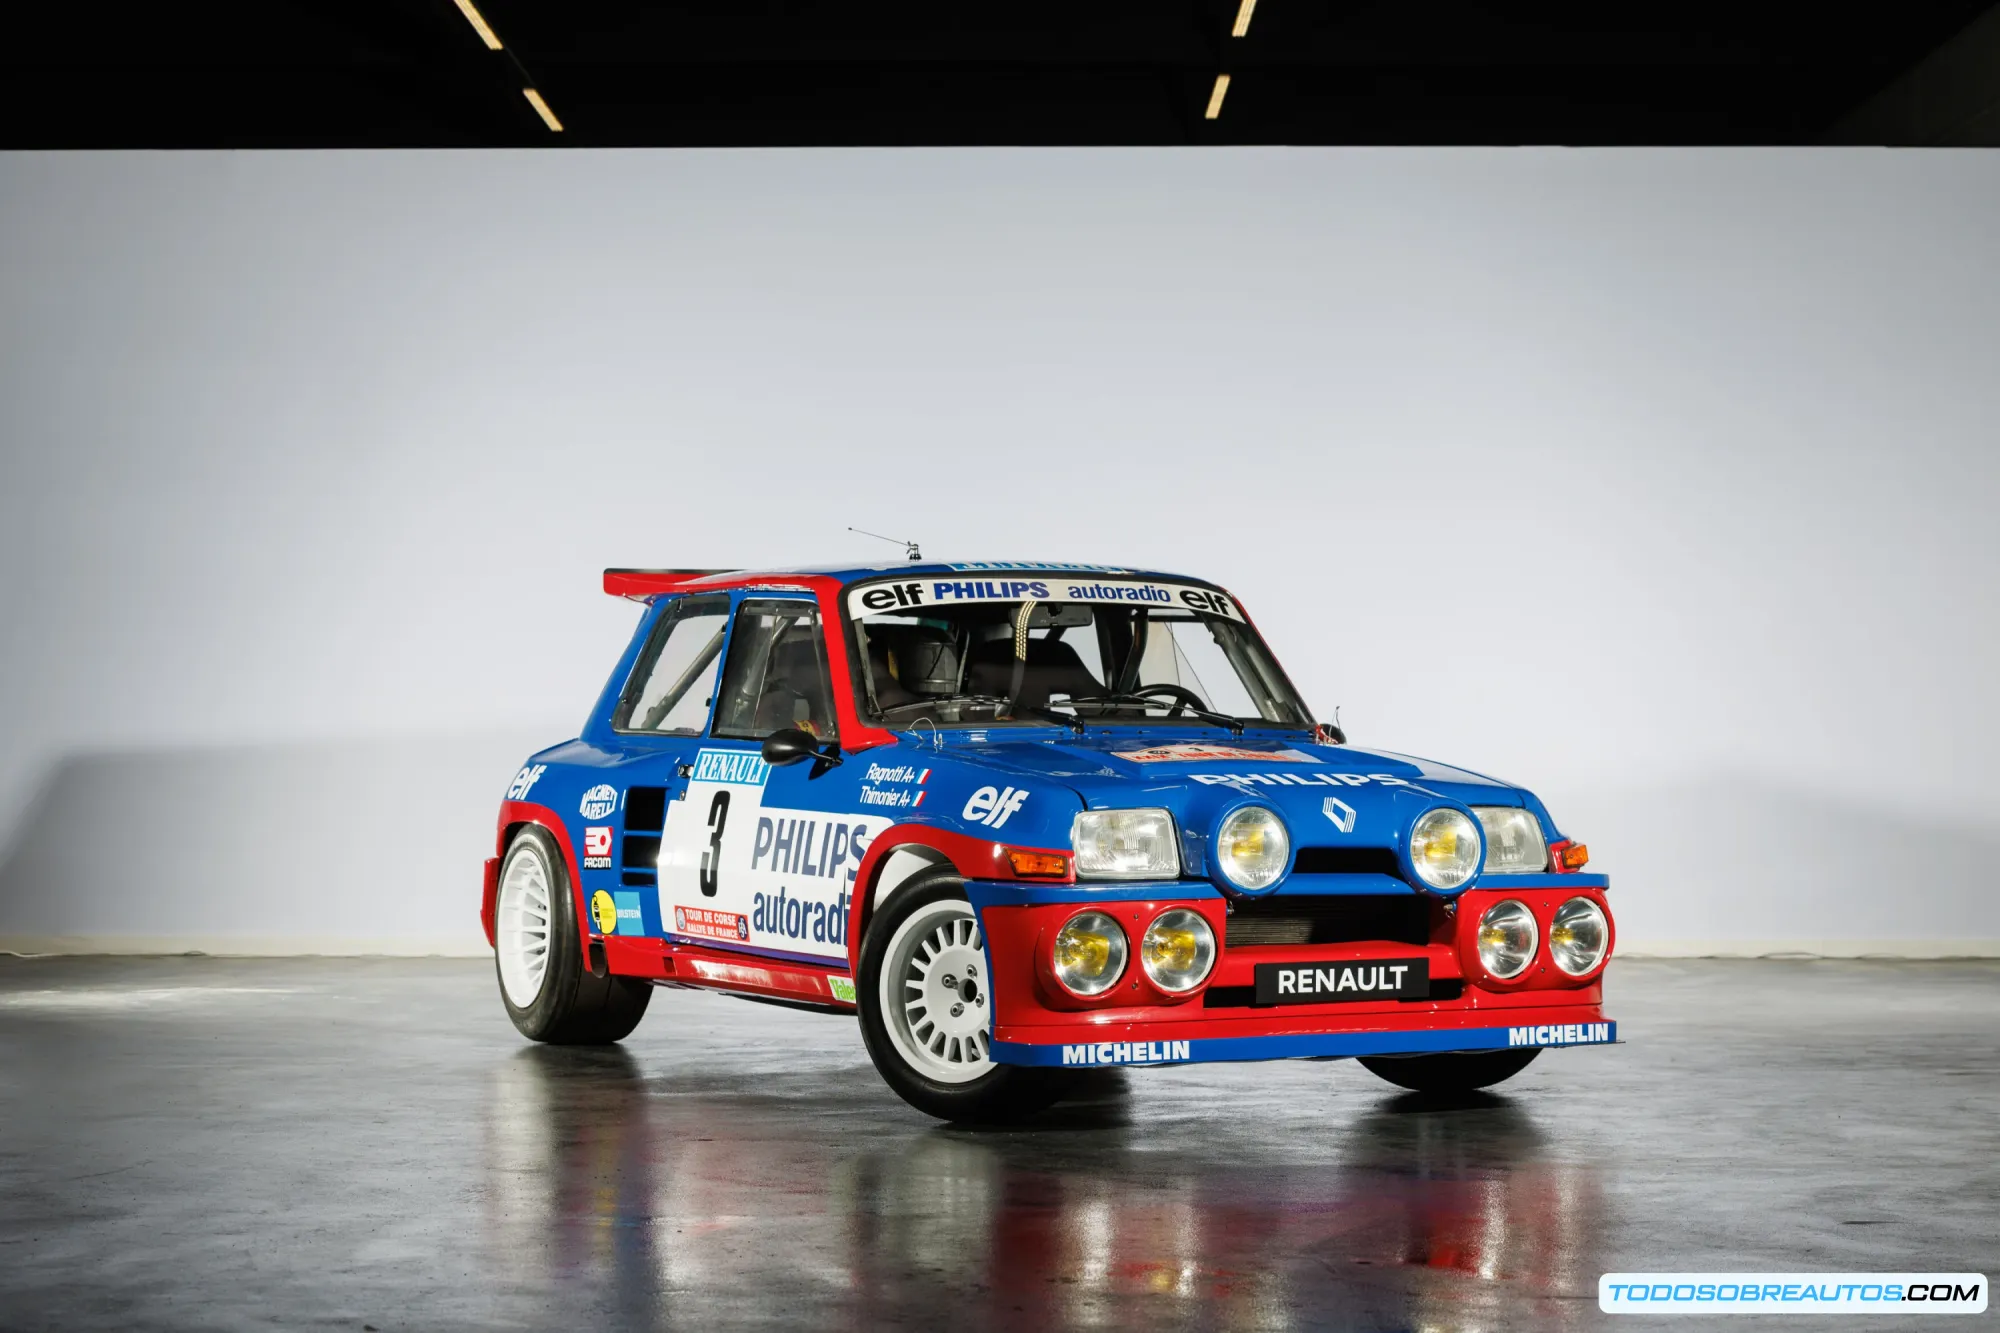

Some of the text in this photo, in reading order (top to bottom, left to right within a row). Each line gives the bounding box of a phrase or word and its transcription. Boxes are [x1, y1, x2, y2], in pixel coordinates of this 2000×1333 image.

[862, 581, 1230, 616] elf PHILIPS autoradio elf
[694, 753, 768, 784] RENAULT
[865, 762, 907, 785] Ragnotti
[1187, 773, 1409, 786] PHILIPS
[507, 764, 547, 800] elf
[860, 785, 901, 807] Thimonier
[962, 785, 1030, 829] elf
[699, 790, 731, 898] 3
[751, 816, 868, 882] PHILIPS
[584, 856, 611, 868] FACOM
[685, 908, 737, 927] TOUR DE CORSE
[686, 922, 739, 939] RALLYE DE FRANCE
[1278, 965, 1408, 994] RENAULT
[1508, 1023, 1609, 1046] MICHELIN
[1062, 1040, 1190, 1065] MICHELIN
